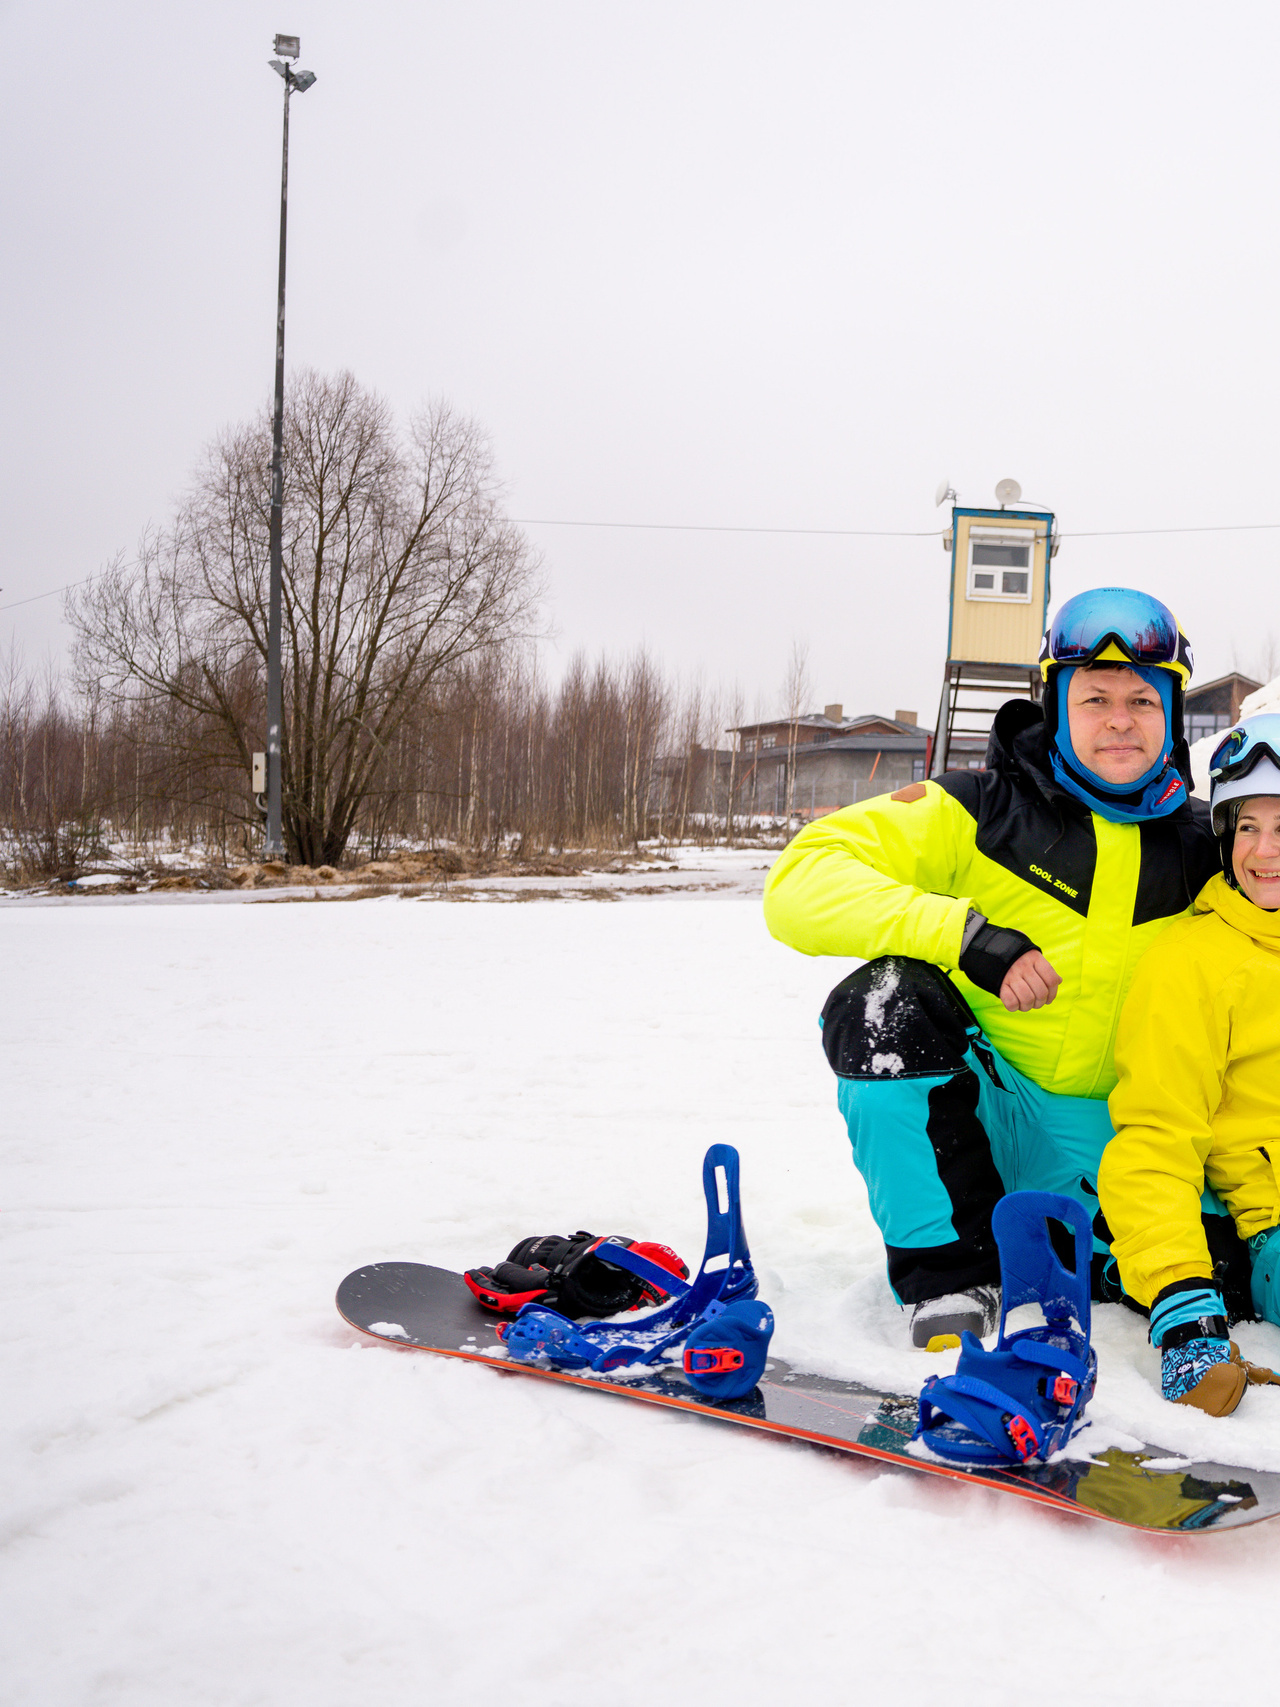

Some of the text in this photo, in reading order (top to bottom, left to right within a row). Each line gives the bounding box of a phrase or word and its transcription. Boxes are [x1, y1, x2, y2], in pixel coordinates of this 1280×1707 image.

[1029, 864, 1079, 899] COOL ZONE
[658, 1245, 680, 1261] MATT
